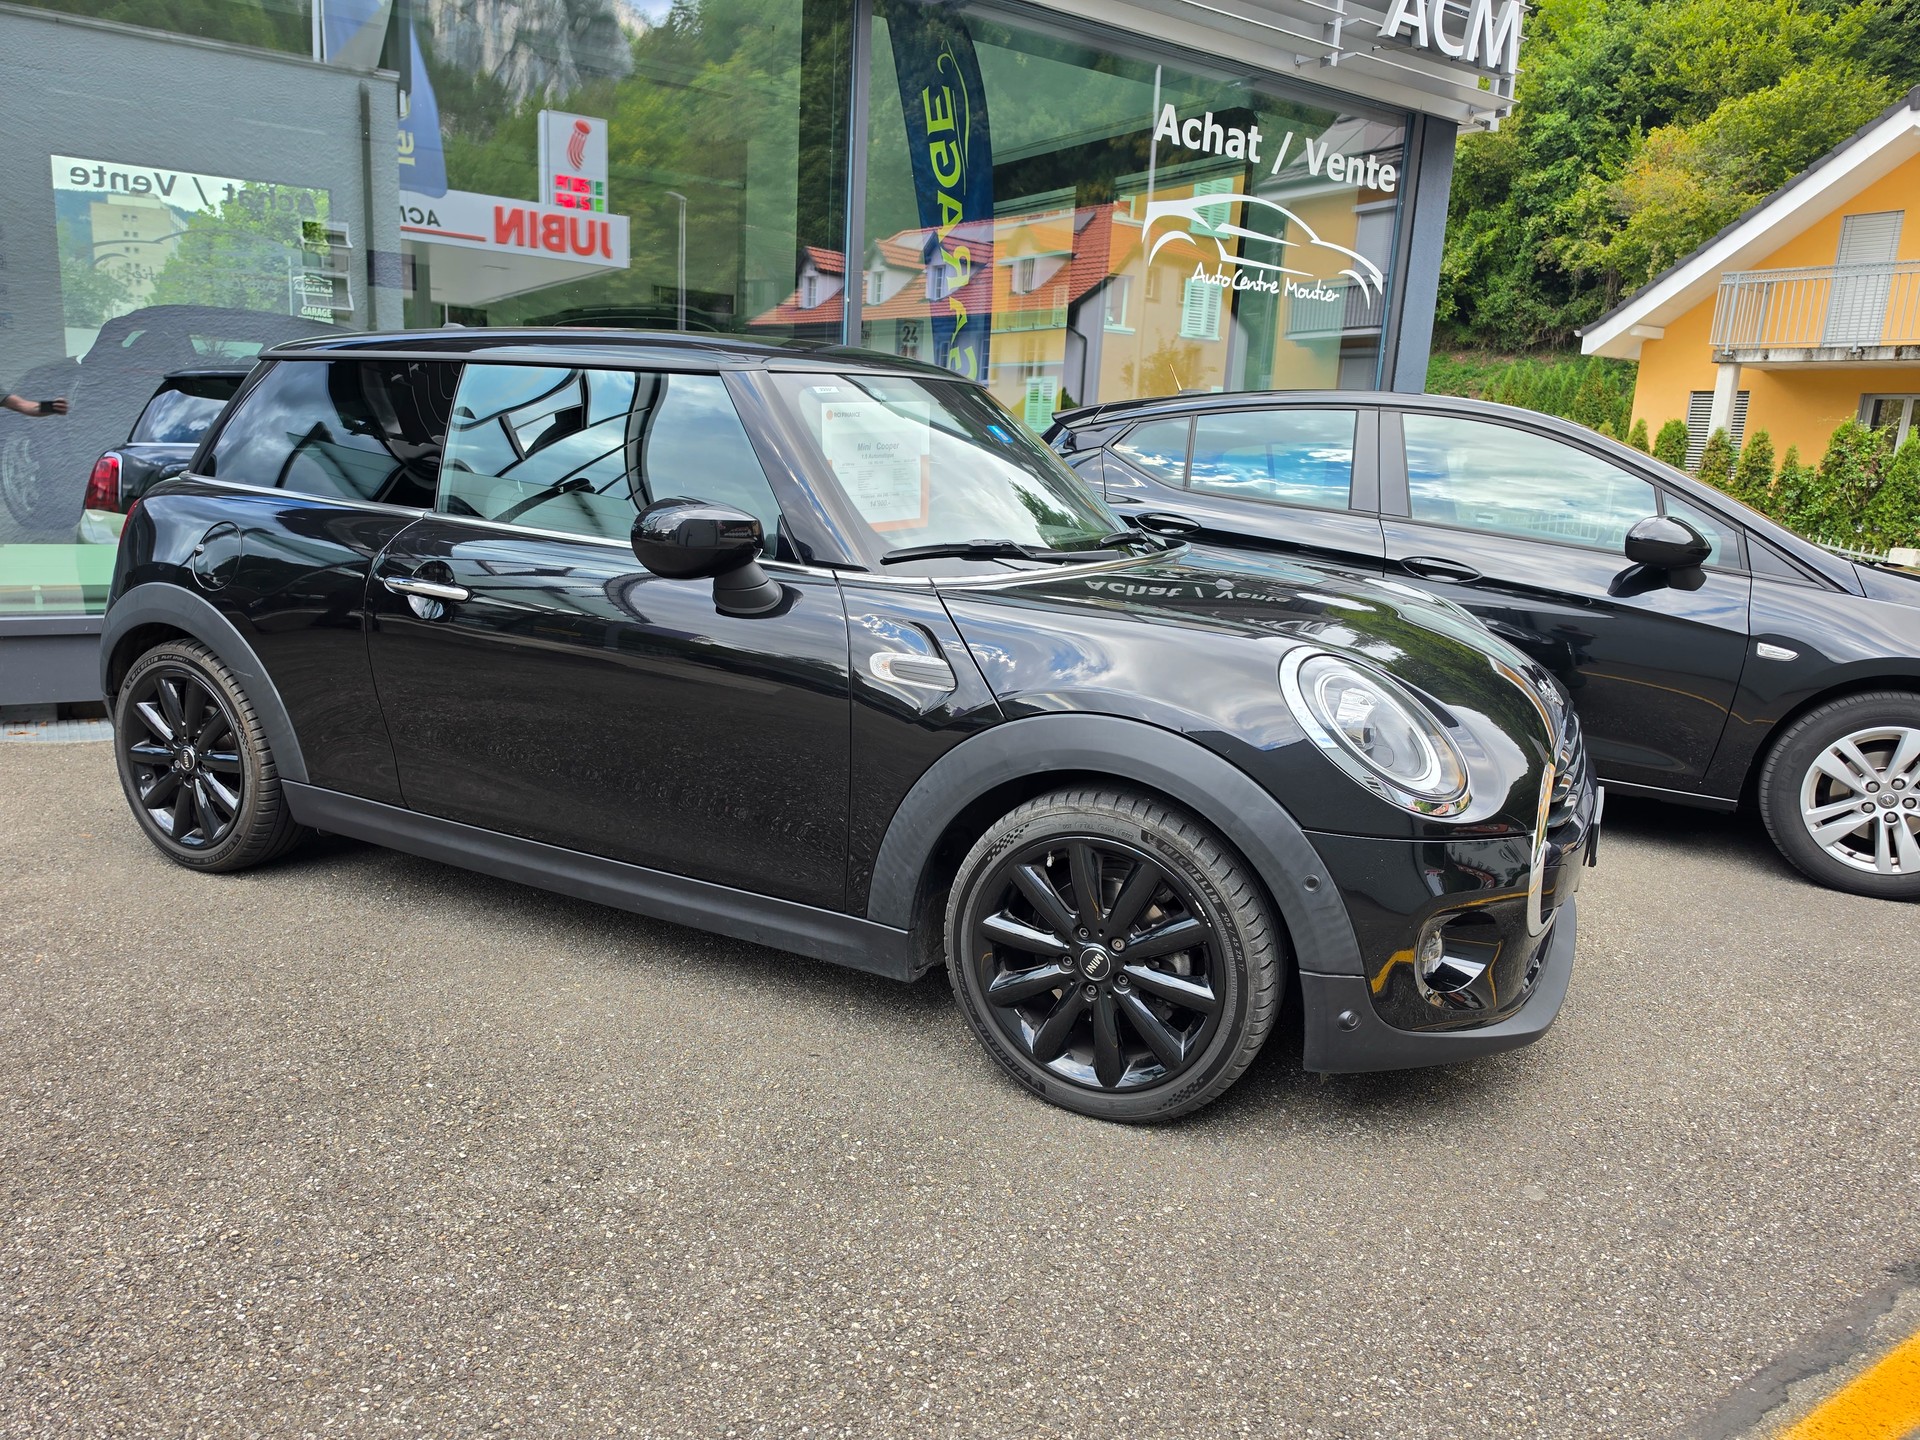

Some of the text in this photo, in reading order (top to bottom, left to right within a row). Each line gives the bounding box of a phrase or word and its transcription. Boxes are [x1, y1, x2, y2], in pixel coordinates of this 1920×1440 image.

[1377, 0, 1520, 76] ACM
[1153, 103, 1397, 193] Achat / Vente
[1284, 276, 1340, 302] Moutier
[301, 306, 332, 317] GARAGE
[902, 325, 919, 344] 24
[857, 442, 900, 452] Mini Cooper
[1161, 843, 1221, 905] MICHELIN
[1085, 953, 1104, 974] MINI
